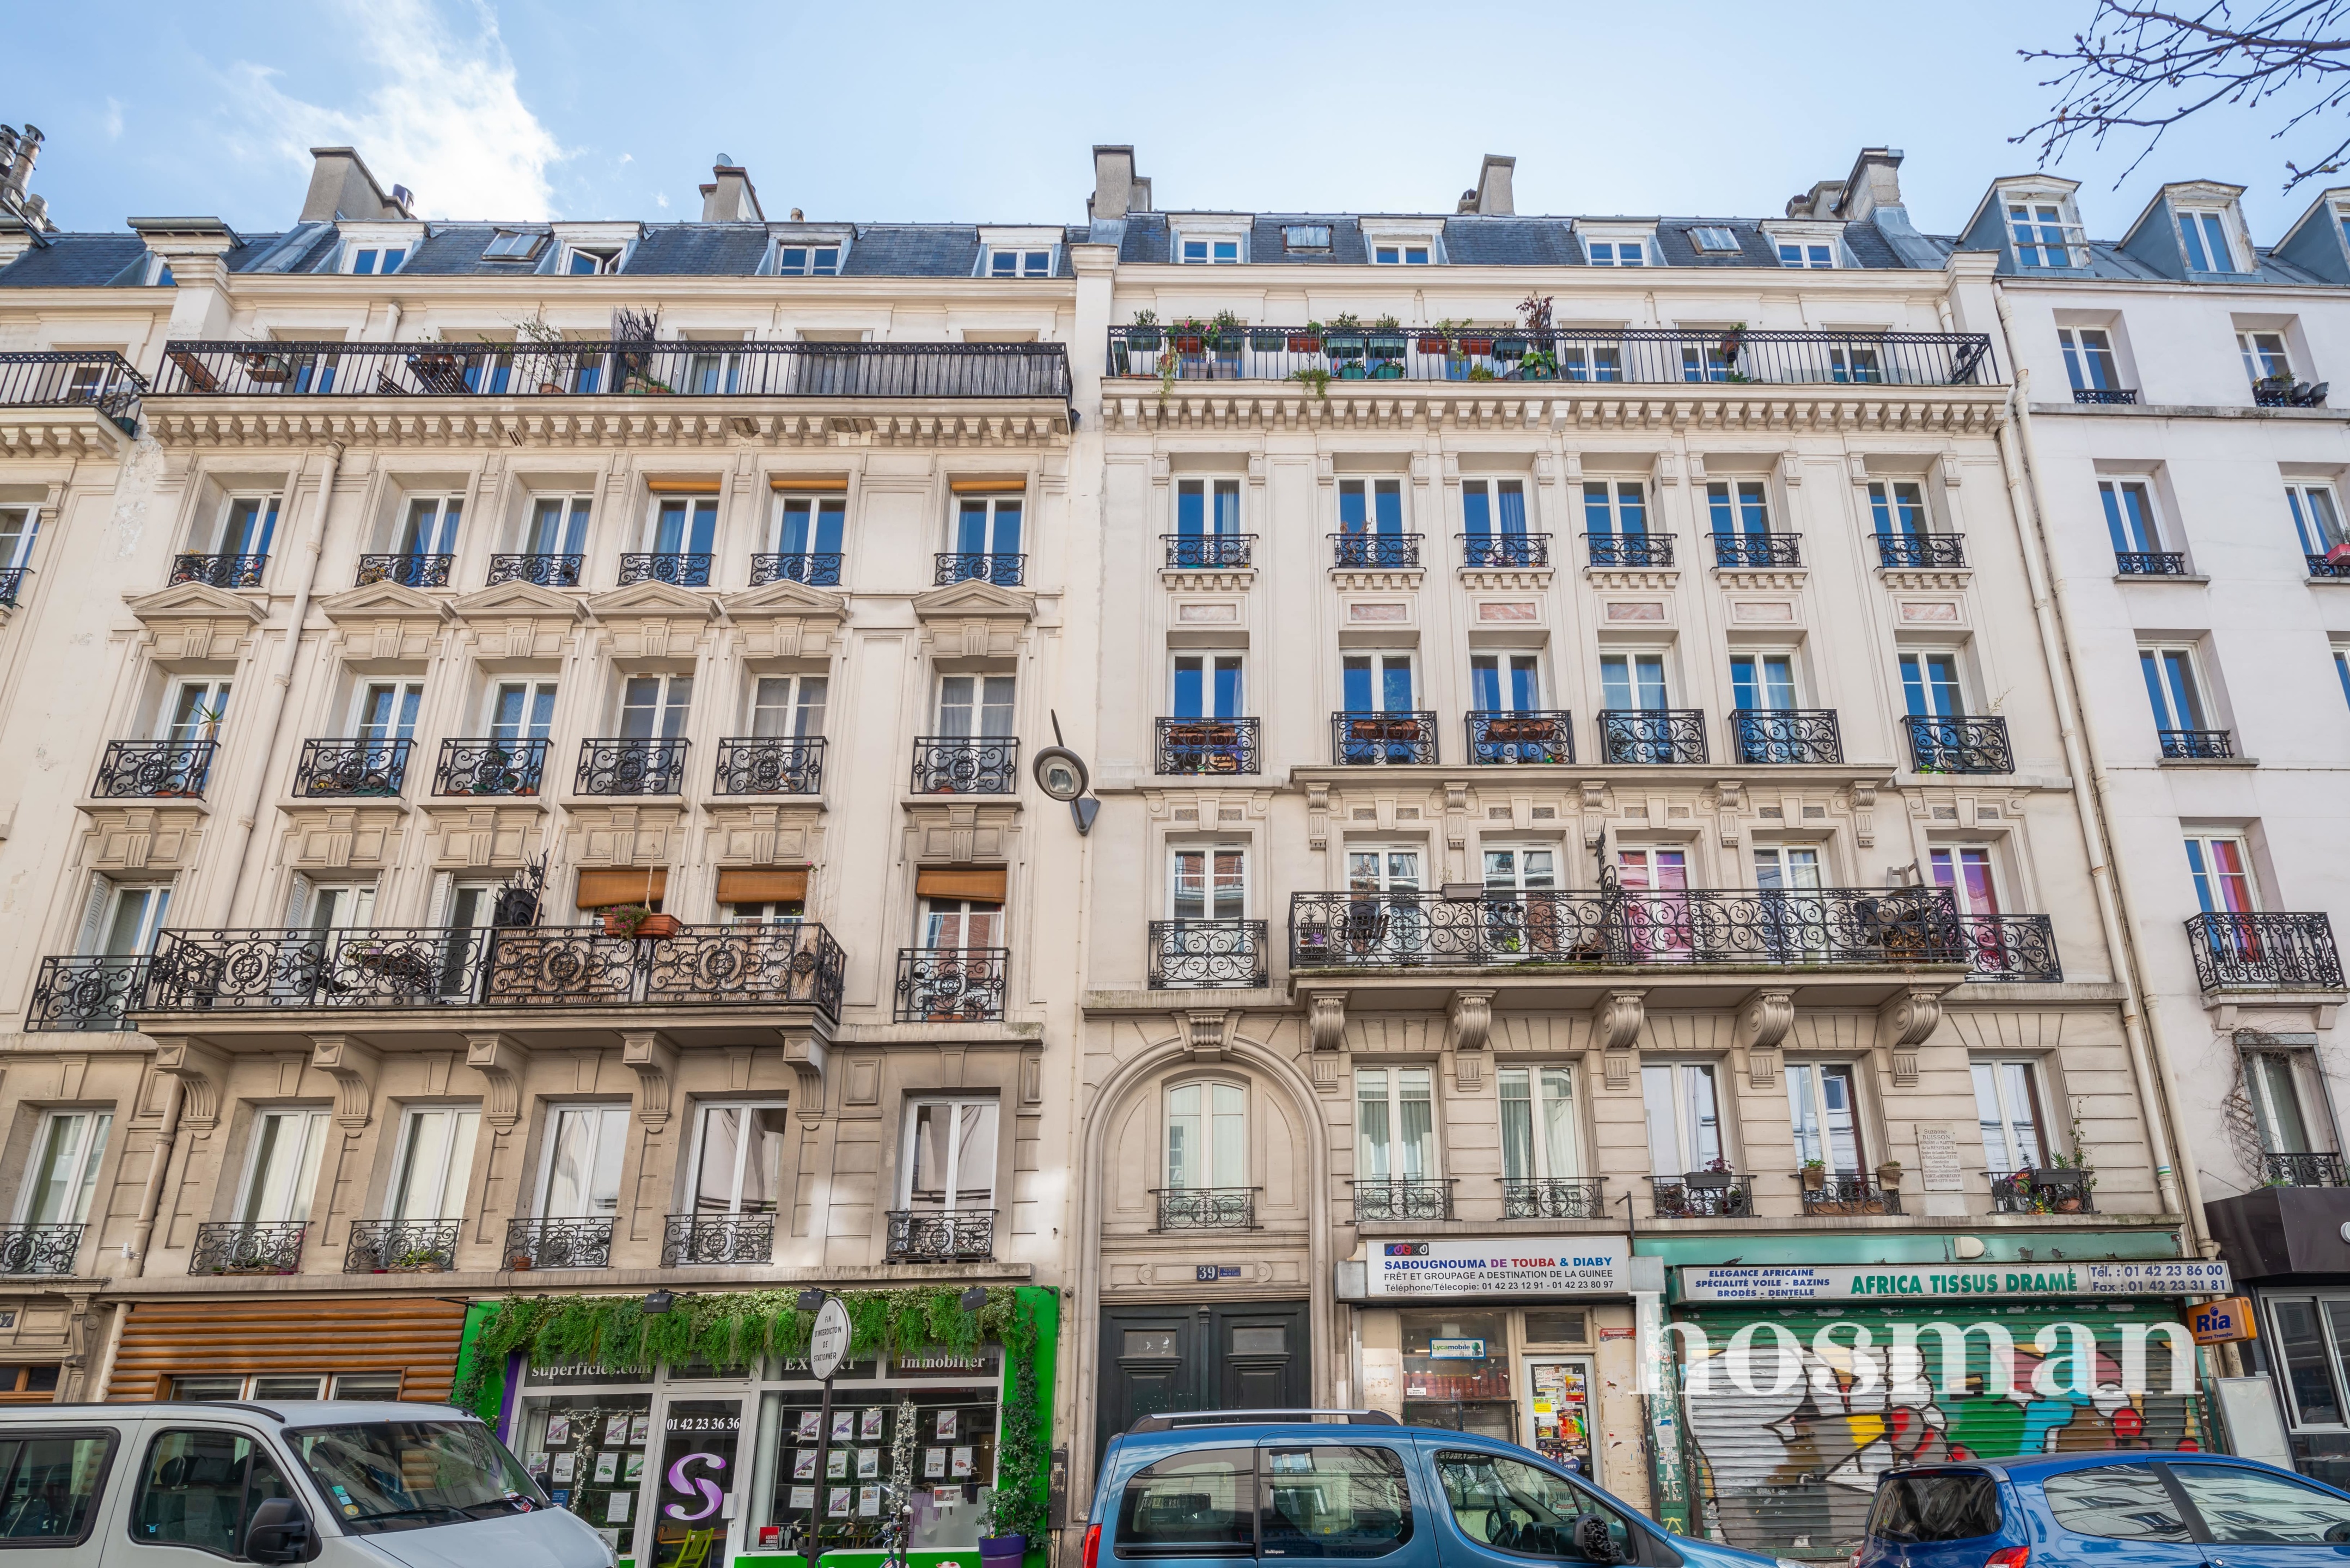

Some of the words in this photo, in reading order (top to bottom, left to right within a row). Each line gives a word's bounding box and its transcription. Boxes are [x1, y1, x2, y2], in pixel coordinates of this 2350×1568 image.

[1384, 1259, 1487, 1270] SABOUGNOUMA
[1491, 1259, 1507, 1267] DE
[1511, 1258, 1556, 1267] TOUBA
[1560, 1258, 1568, 1266] &
[1573, 1257, 1613, 1266] DIABY
[1199, 1266, 1215, 1279] 39
[1384, 1272, 1408, 1281] FRÊT
[1487, 1271, 1547, 1279] DESTINATION
[2090, 1266, 2112, 1277] Tél.
[2125, 1266, 2139, 1277] 01
[2145, 1266, 2162, 1277] 42
[2166, 1266, 2182, 1276] 23
[2186, 1265, 2202, 1276] 86
[2206, 1265, 2223, 1276] 00
[1695, 1278, 1749, 1288] SPÉCIALITÉ
[1851, 1275, 1923, 1294] AFRICA
[1930, 1274, 1998, 1293] TISSUS
[2006, 1268, 2078, 1292] DRAMÉ
[2092, 1282, 2116, 1292] Fax
[2128, 1281, 2143, 1291] 01
[2149, 1281, 2165, 1291] 42
[2170, 1281, 2186, 1291] 23
[2190, 1280, 2205, 1290] 31
[2211, 1280, 2225, 1290] 81
[1717, 1288, 1756, 1297] BRODÉS
[2196, 1306, 2231, 1333] Ria
[815, 1326, 842, 1337] D'INTERDICTION
[814, 1352, 837, 1362] STATIONNER
[784, 1357, 857, 1370] EXT
[532, 1362, 652, 1380] superficie.com
[667, 1419, 678, 1430] 01
[680, 1418, 693, 1430] 42
[695, 1418, 709, 1430] 23
[711, 1418, 725, 1429] 36
[727, 1418, 741, 1429] 36
